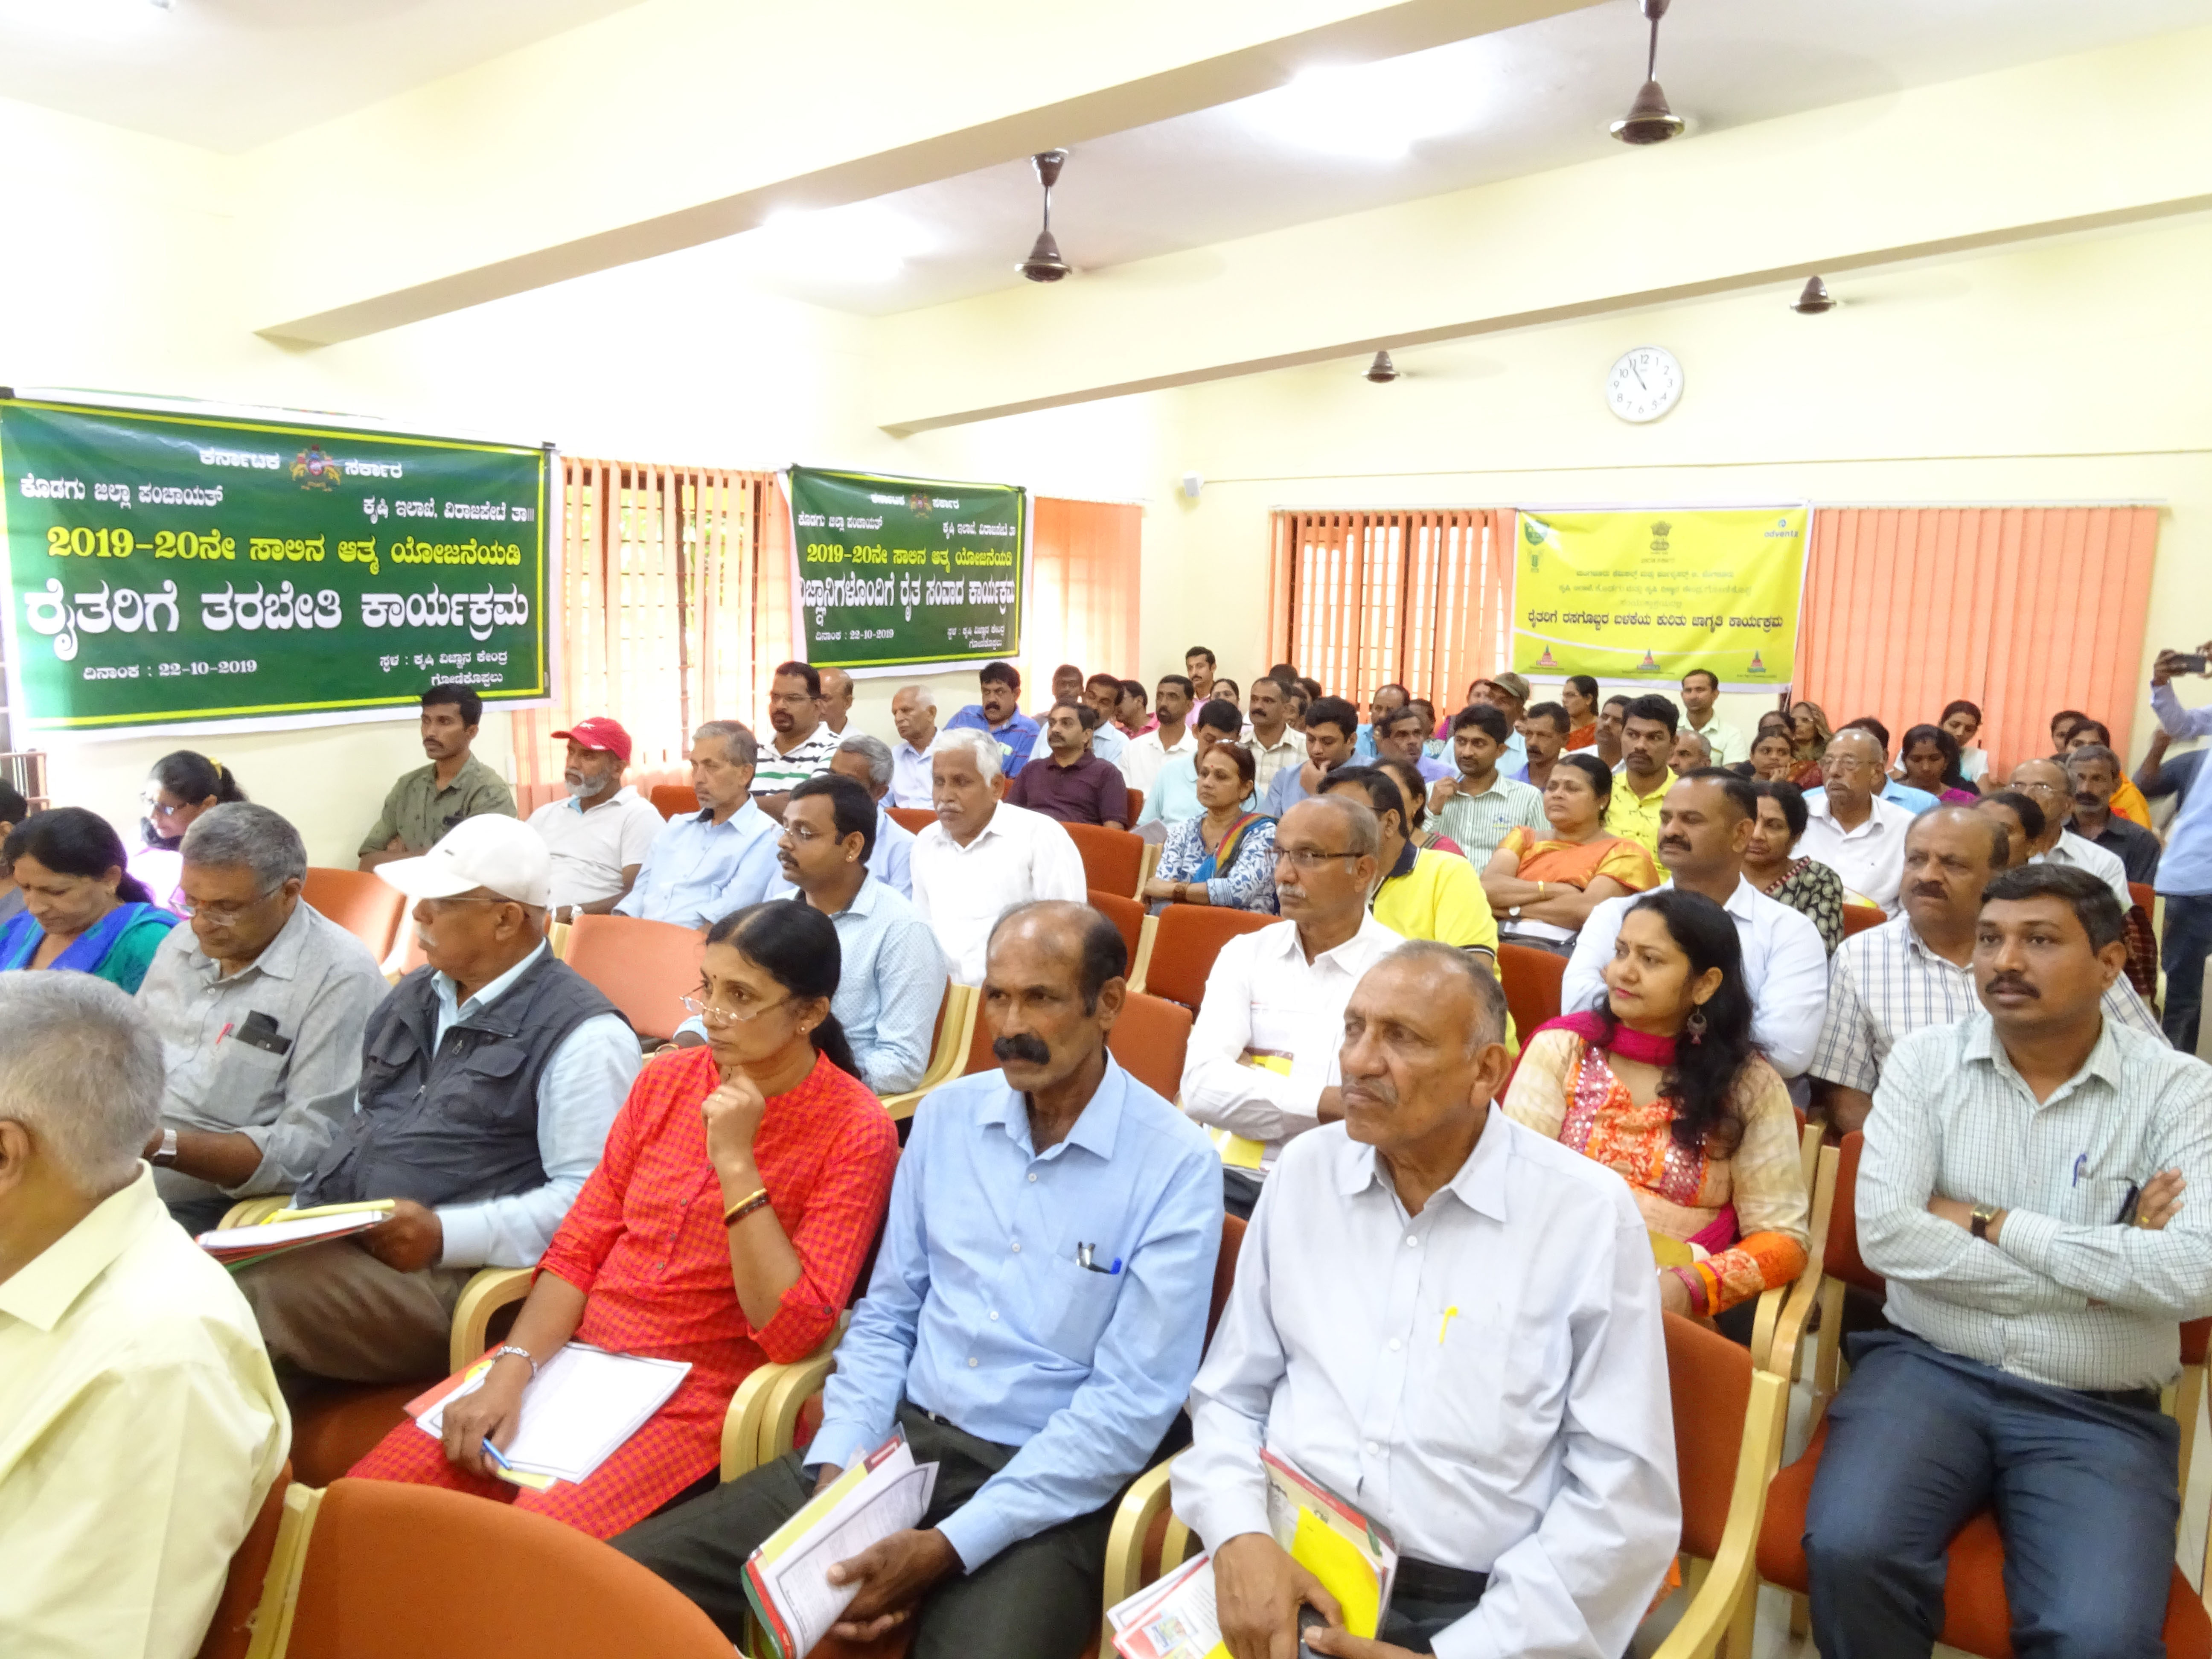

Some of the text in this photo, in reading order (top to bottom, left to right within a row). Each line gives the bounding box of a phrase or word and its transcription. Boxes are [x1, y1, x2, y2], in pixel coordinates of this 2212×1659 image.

[1640, 354, 1649, 364] 12
[1619, 369, 1628, 378] 10
[1664, 365, 1669, 375] 2
[1613, 381, 1619, 390] 9
[1667, 378, 1673, 388] 3
[1617, 393, 1623, 402] 8
[1638, 405, 1644, 414] 6
[199, 447, 403, 478] ಕರ್ನಾಟಕ ಸರ್ಕಾರ
[20, 473, 85, 500] ಕೊಡಗು
[93, 483, 131, 509] ಜಿಲ್ಲಾ
[363, 495, 389, 524] ಕೃಷಿ
[47, 526, 521, 576] 2019-20ನೇ ಸಾಲಿನ ಆತ್ಮ ಯೋಜನೆಯಡಿ
[900, 572, 921, 622] ರೈತ
[24, 578, 529, 661] ರೈತರಿಗೆ ತರಬೇತಿ ಕಾರ್ಯಕ್ರಮ
[850, 629, 894, 640] 22-10-2019
[158, 659, 257, 677] 22-10-2019
